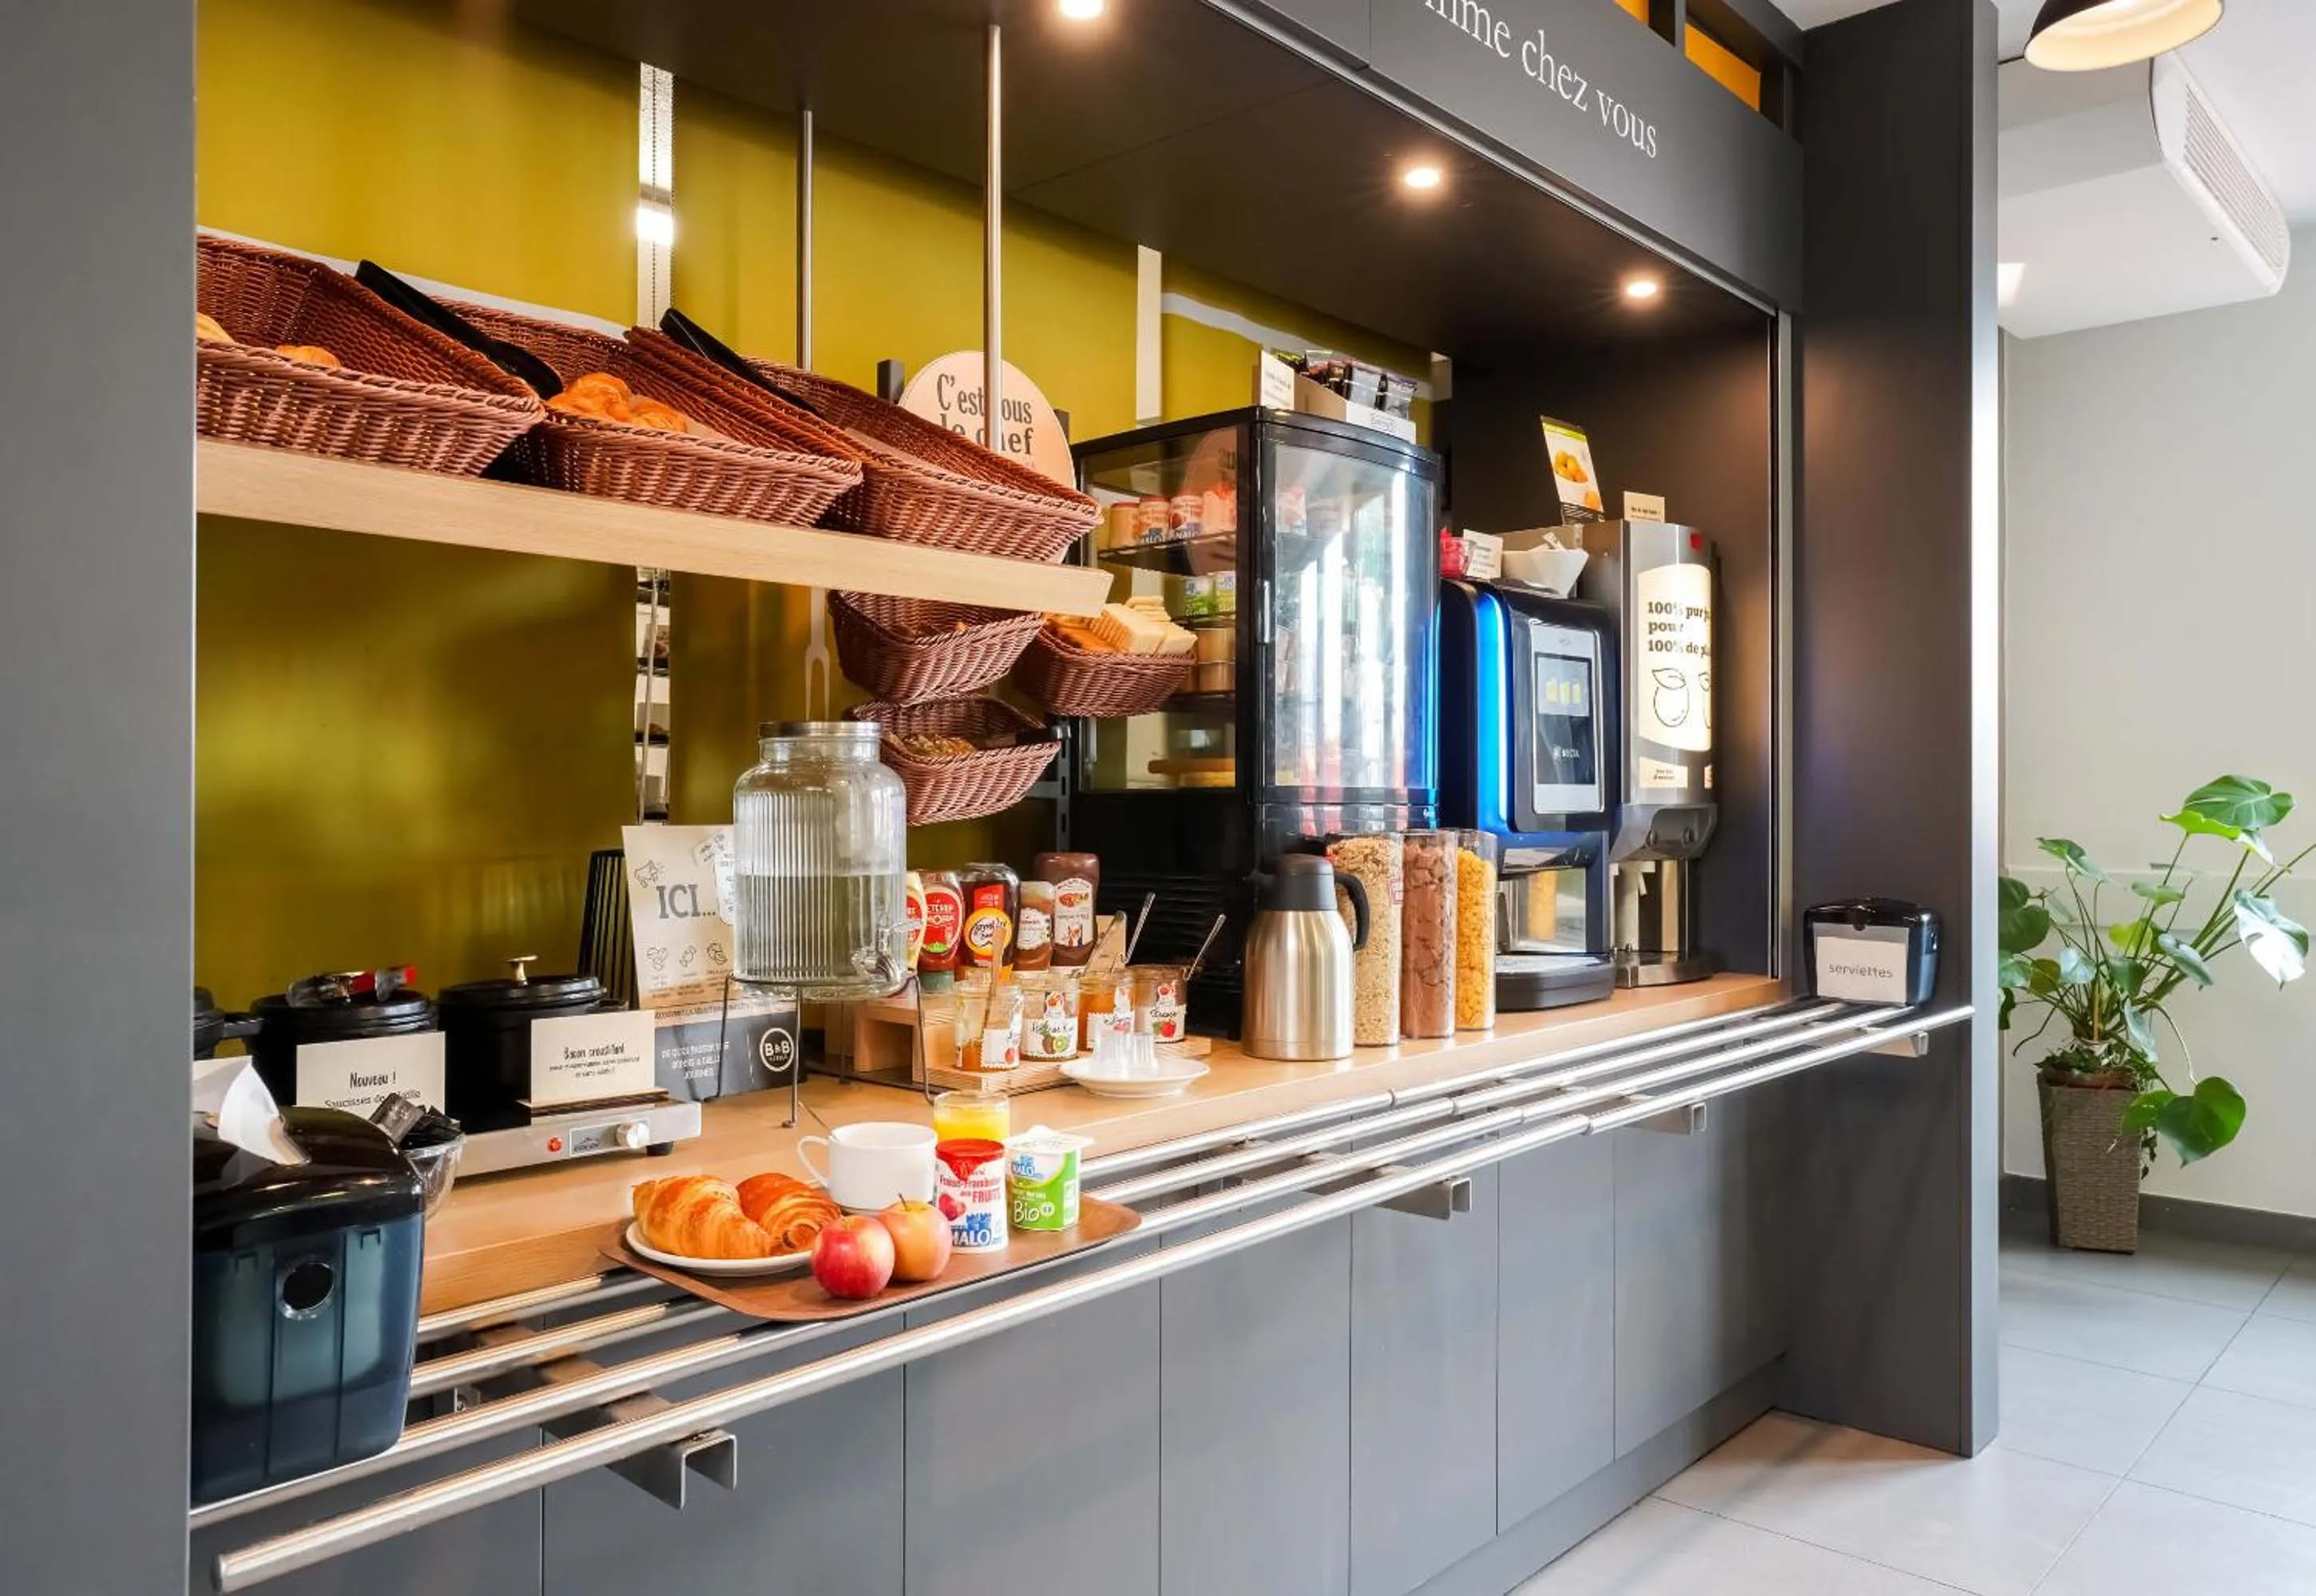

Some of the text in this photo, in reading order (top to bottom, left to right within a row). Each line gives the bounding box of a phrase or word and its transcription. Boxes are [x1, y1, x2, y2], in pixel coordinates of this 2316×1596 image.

[1521, 29, 1589, 113] chez
[1596, 89, 1658, 158] vous
[1001, 398, 1033, 425] ous
[1685, 641, 1699, 655] de
[1829, 964, 1894, 979] serviettes
[765, 1040, 790, 1057] B&B
[350, 1071, 397, 1089] Nouveau !
[1013, 1200, 1040, 1223] Bio
